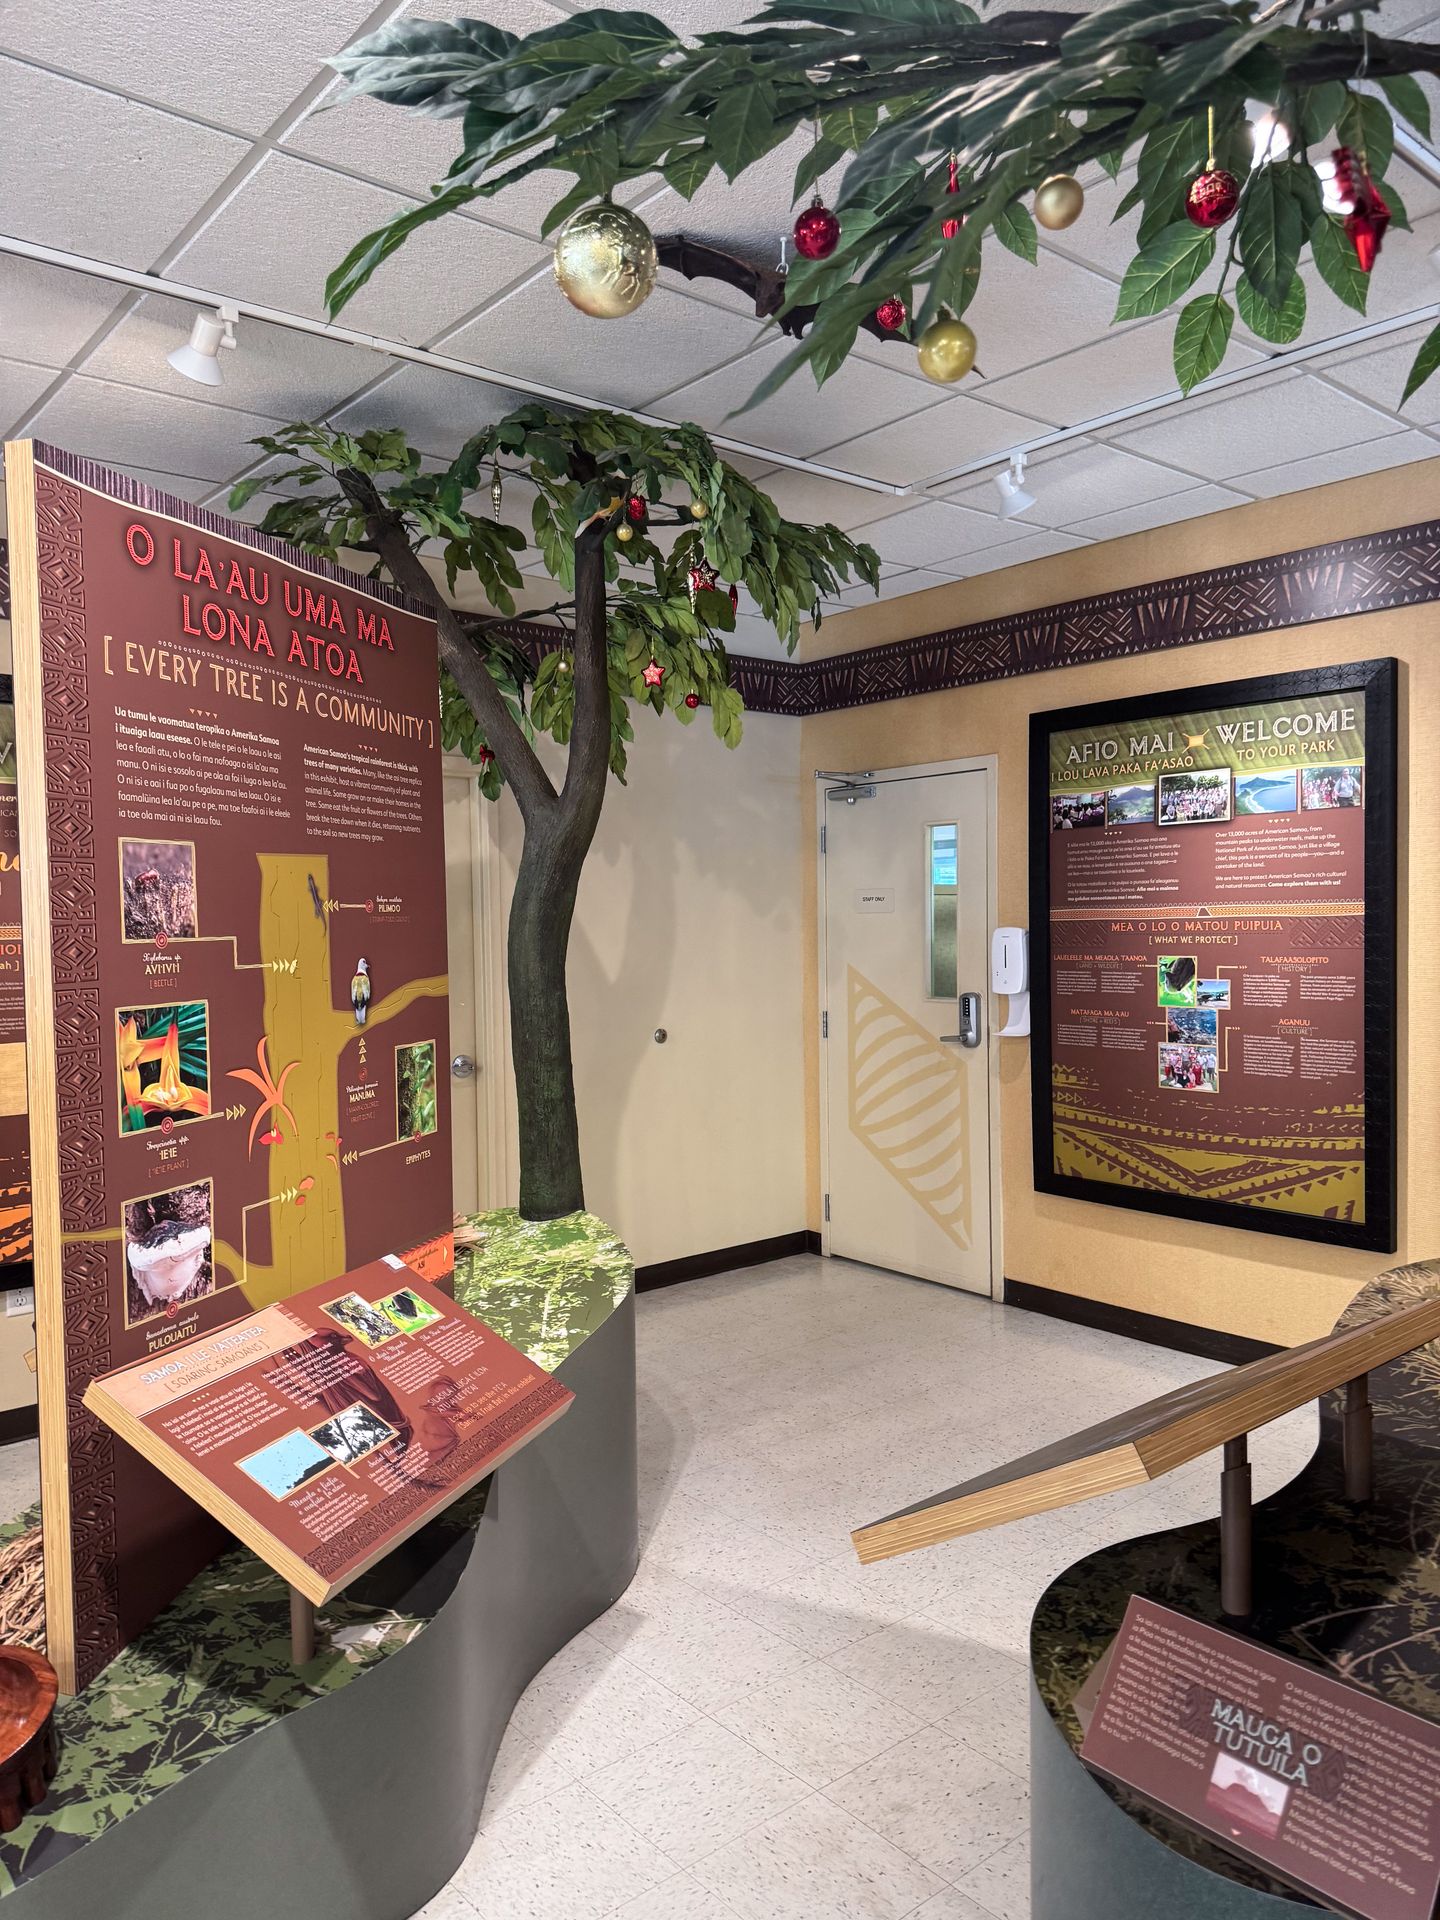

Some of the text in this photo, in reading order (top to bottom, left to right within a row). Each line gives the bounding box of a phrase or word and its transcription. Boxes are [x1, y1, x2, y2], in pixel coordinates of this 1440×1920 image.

[125, 524, 395, 652] O LA'AU UMA MA
[182, 594, 364, 684] LONA ATOA
[125, 642, 425, 741] EVERY TREE IS A COMMUNITY
[114, 706, 126, 717] Ua
[128, 709, 148, 721] tumu
[150, 712, 156, 722] le
[158, 716, 194, 729] vaomatua
[196, 722, 224, 735] teropika
[231, 728, 258, 741] Amerika
[259, 734, 280, 746] Samoa
[120, 724, 147, 738] ituaiga
[148, 728, 165, 740] laau
[194, 736, 200, 746] O
[202, 738, 208, 748] le
[1216, 708, 1356, 745] WELCOME
[116, 740, 128, 750] lea
[128, 744, 134, 752] e
[304, 744, 329, 756] American
[1066, 732, 1174, 765] AFIO MAI
[1237, 740, 1335, 760] TO YOUR PARK
[304, 758, 318, 768] trees
[1058, 770, 1079, 781] LOU
[1082, 766, 1110, 779] LAVA
[1112, 762, 1141, 775] PAKA
[127, 810, 140, 819] toe
[1111, 920, 1283, 932] MEA O LO O MATOU PUIPUIA
[1154, 936, 1178, 944] WHAT
[1195, 936, 1232, 944] PROTECT
[148, 1323, 197, 1353] PULOUAITU
[216, 1342, 262, 1368] SAMOANS
[1213, 1721, 1308, 1787] TUTUILA
[1302, 1744, 1322, 1765] O
